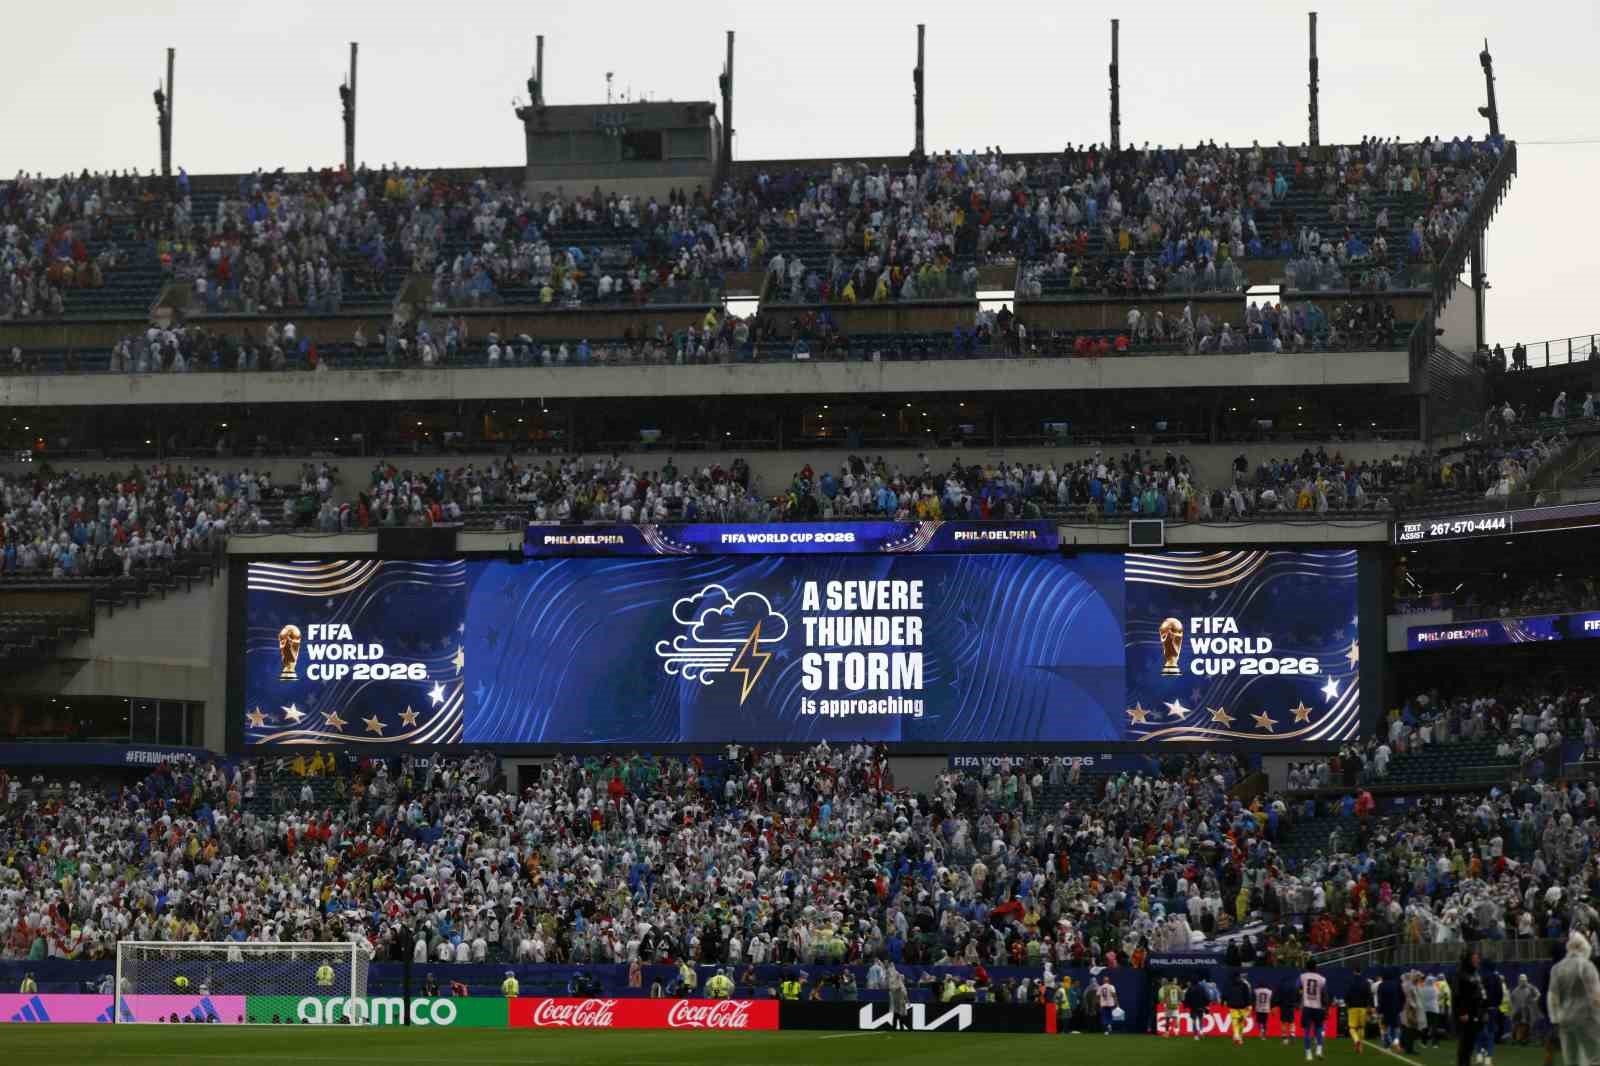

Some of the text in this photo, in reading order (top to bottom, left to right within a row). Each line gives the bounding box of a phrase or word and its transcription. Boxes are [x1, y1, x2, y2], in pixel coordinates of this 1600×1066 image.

[1403, 523, 1422, 533] TEXT
[1430, 518, 1505, 535] 267-570-4444
[543, 535, 625, 545] PHILADELPHIA
[721, 532, 856, 544] FIFA WORLD CUP 2026
[954, 530, 1037, 540] PHILADELPHIA
[1400, 531, 1425, 541] ASSIST
[802, 580, 923, 611] A SEVERE
[308, 624, 352, 640] FIFA
[803, 616, 923, 646] THUNDER
[1191, 617, 1238, 633] FIFA
[1417, 629, 1488, 642] PHILADELPHIA
[307, 644, 383, 660] WORLD
[1190, 638, 1272, 654] WORLD
[307, 663, 427, 680] CUP 2026
[802, 652, 923, 690] STORM
[1191, 658, 1320, 675] CUP 2026
[801, 696, 923, 717] is approaching
[954, 757, 979, 766] FIFA
[534, 999, 616, 1026] Coca-Cola
[668, 1000, 752, 1028] Coca-Cola
